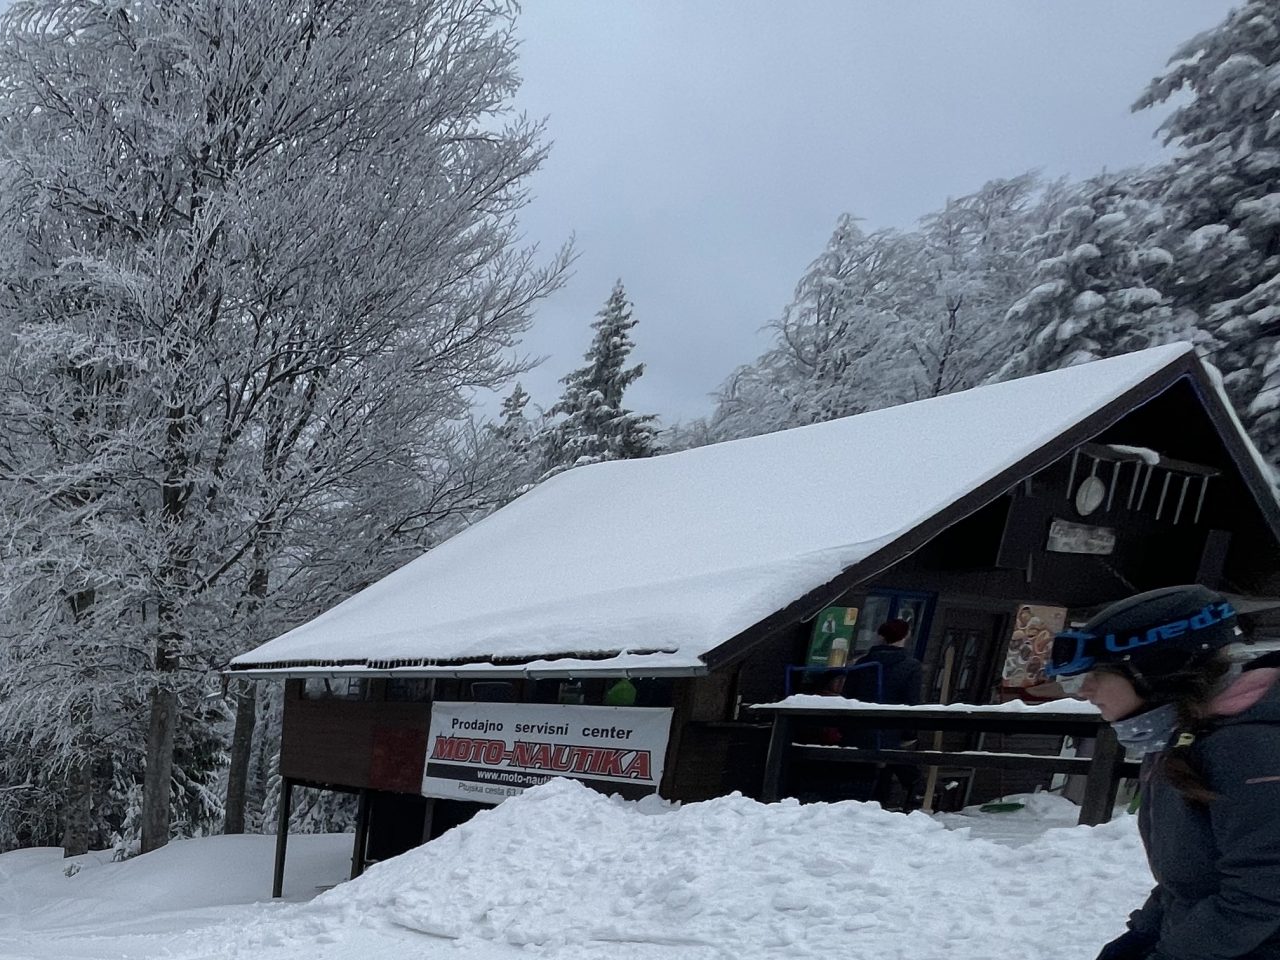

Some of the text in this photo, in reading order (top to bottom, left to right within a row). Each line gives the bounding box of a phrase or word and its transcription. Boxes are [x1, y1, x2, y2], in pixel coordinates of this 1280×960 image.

[451, 718, 633, 740] Prodajno servisni center
[430, 735, 654, 781] MOTO-NAUTIKA
